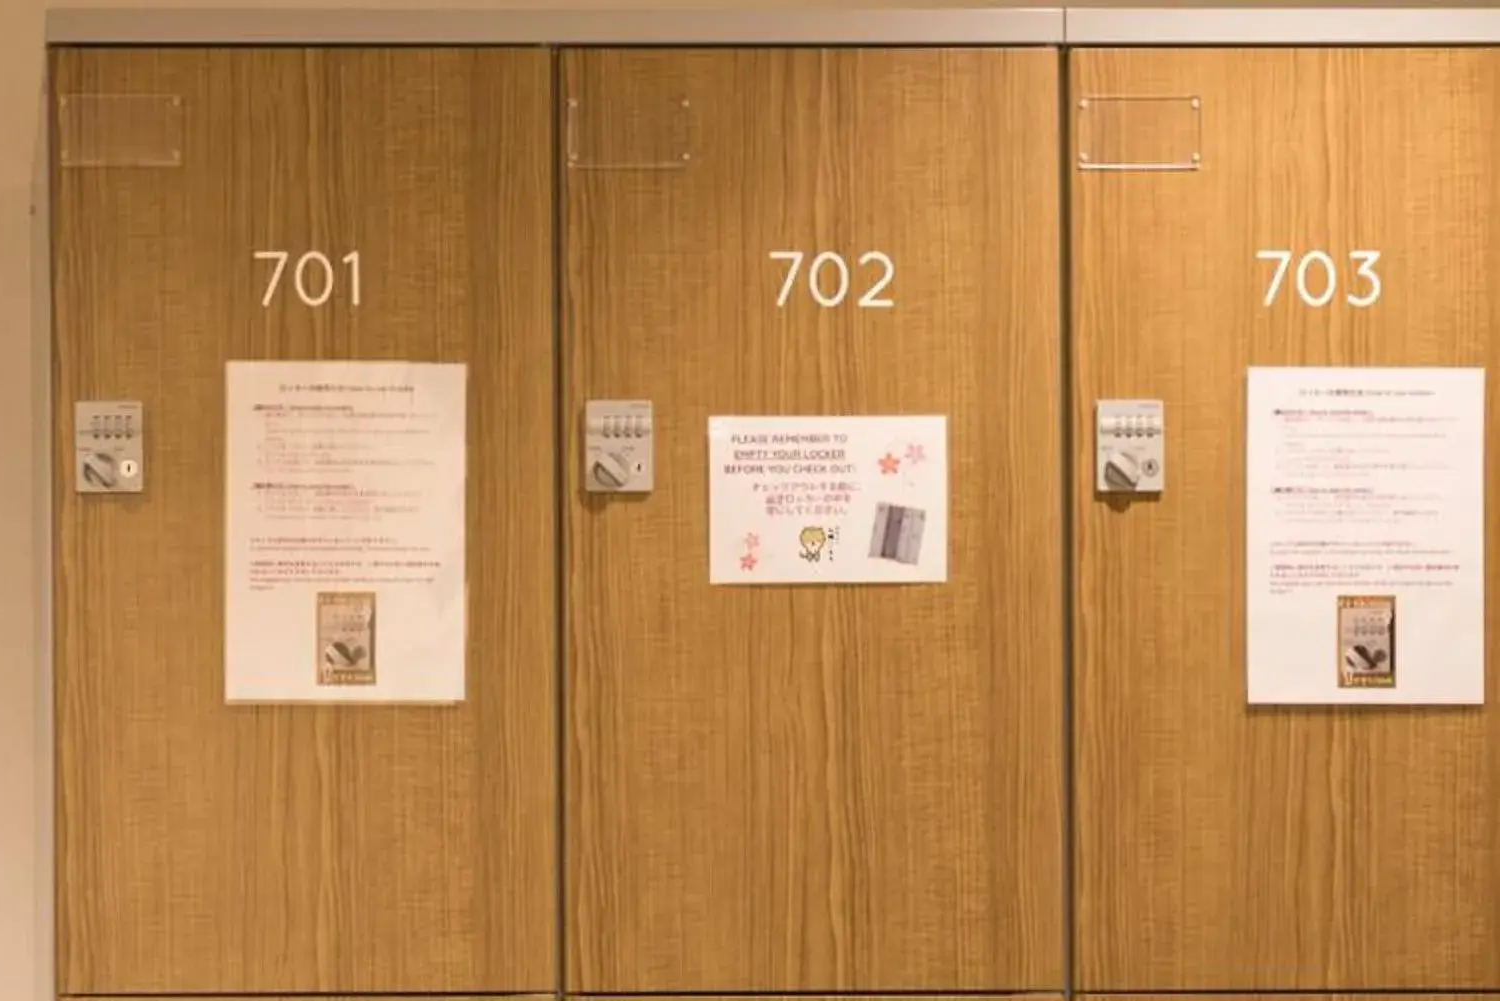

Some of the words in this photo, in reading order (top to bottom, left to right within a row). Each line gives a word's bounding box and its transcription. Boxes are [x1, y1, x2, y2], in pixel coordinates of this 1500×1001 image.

[255, 251, 361, 308] 701
[769, 250, 896, 310] 702
[1255, 248, 1384, 310] 703
[731, 434, 768, 444] PLEASE
[772, 434, 831, 444] REMEMBER
[833, 434, 848, 443] TO
[733, 449, 768, 460] EMPTY
[772, 449, 801, 460] YOUR
[804, 449, 845, 460] LOCKER
[724, 464, 764, 474] BEFORE
[768, 464, 791, 474] YOU
[792, 464, 827, 474] CHECK
